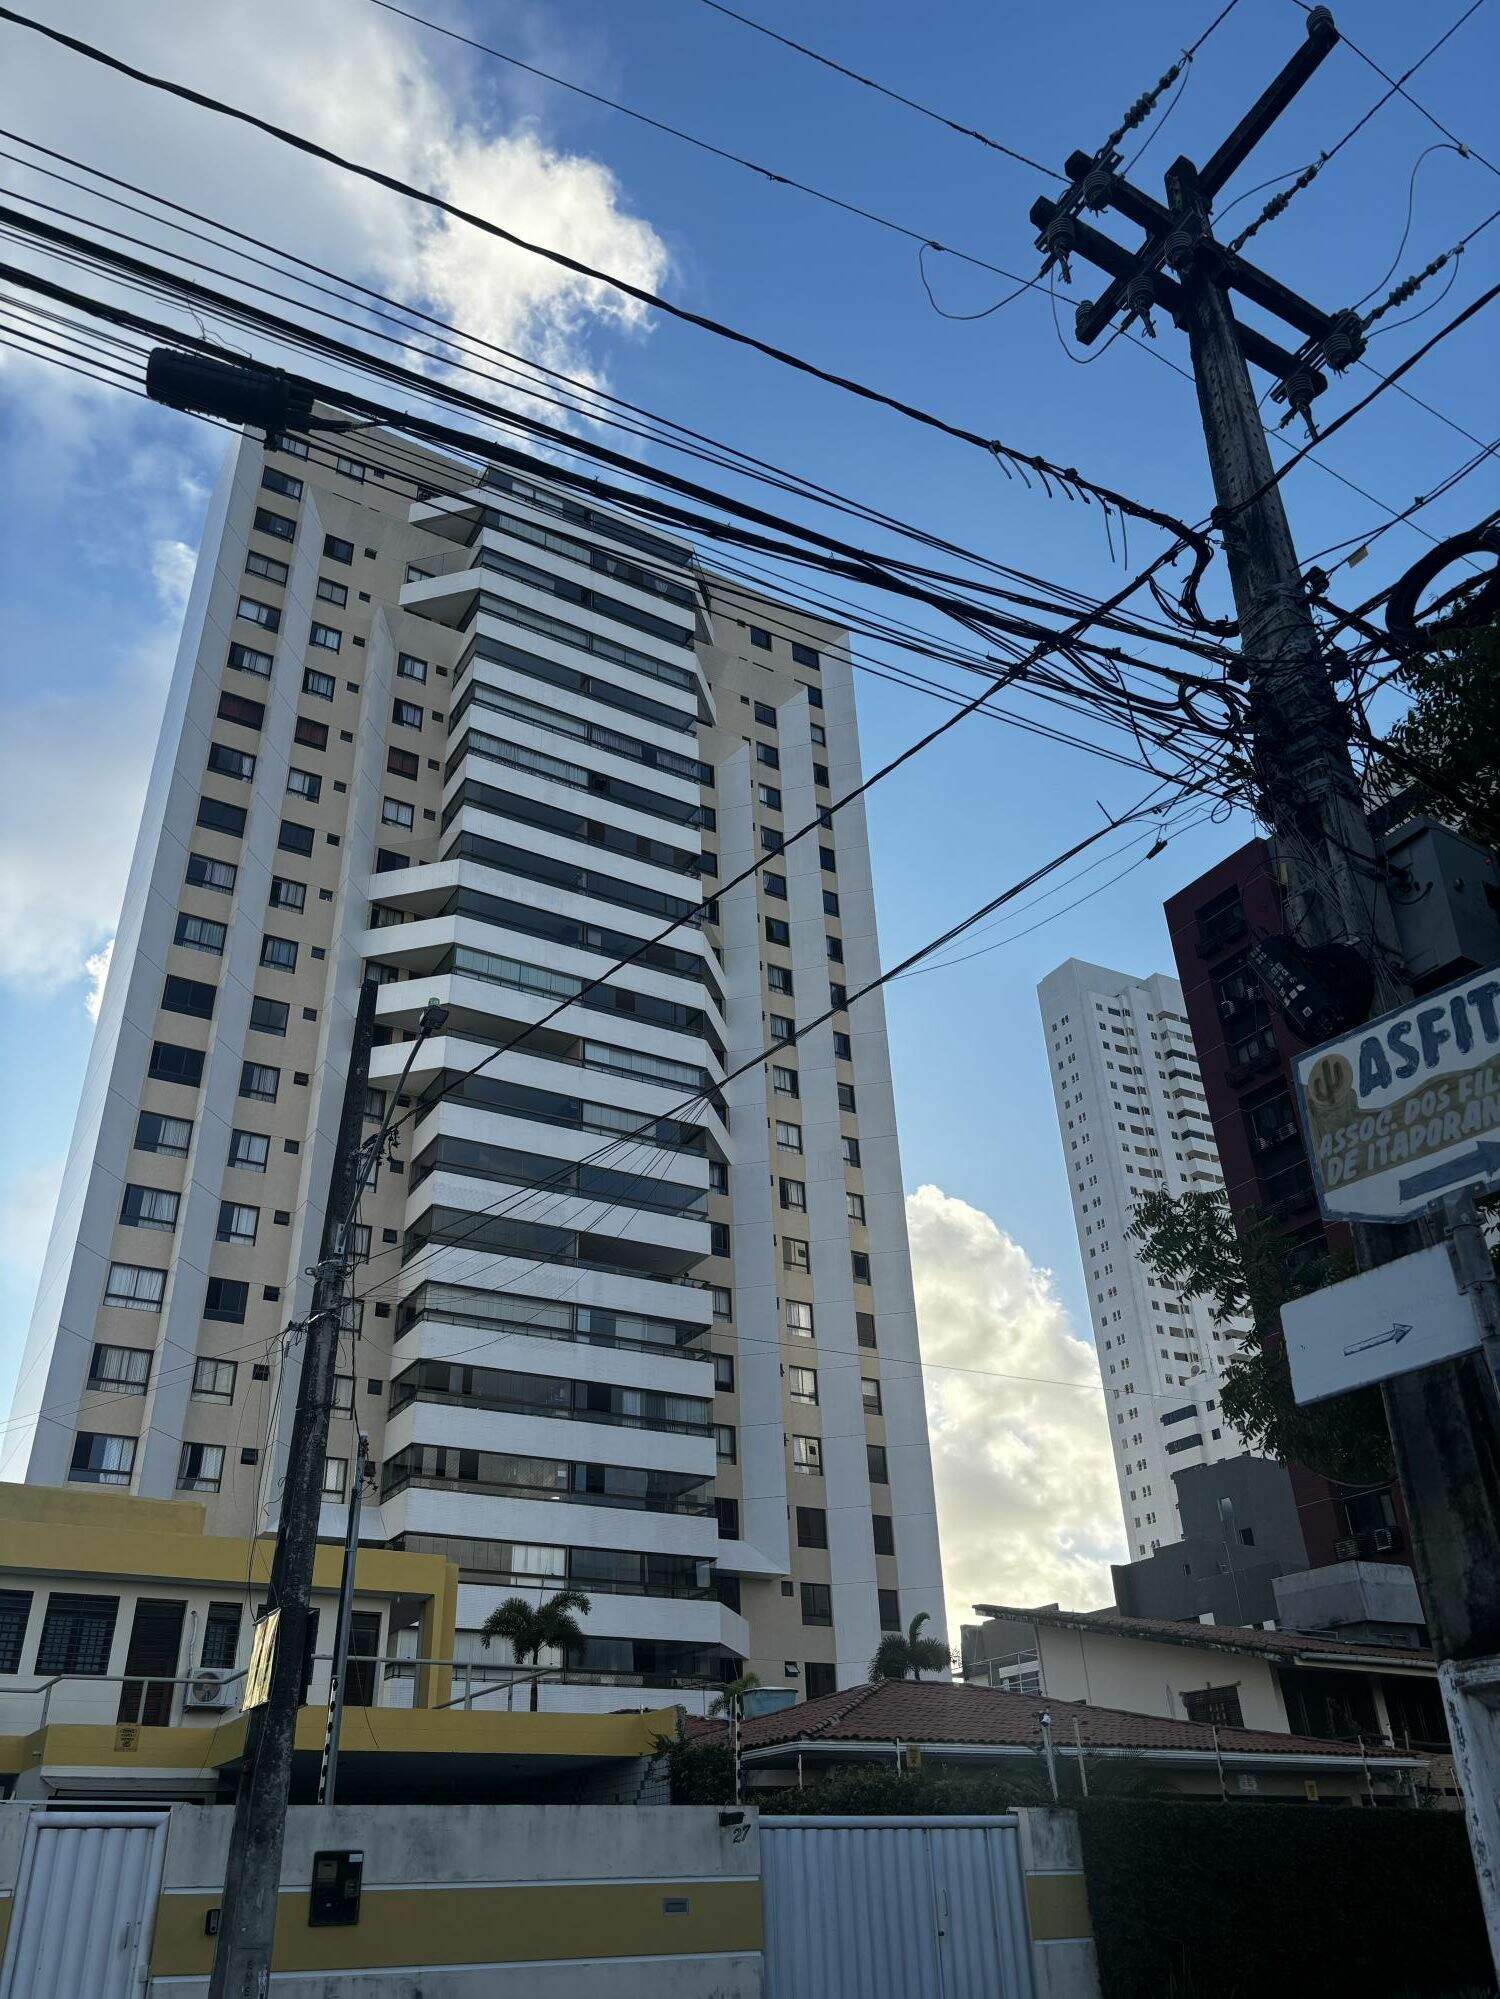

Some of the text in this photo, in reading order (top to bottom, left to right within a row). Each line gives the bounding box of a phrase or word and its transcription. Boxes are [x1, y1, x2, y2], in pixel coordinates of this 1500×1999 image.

[1359, 981, 1500, 1098] ASFIT
[1320, 1109, 1397, 1160] ASSOC.
[1404, 1083, 1451, 1123] DOS
[1326, 1151, 1359, 1187] DE
